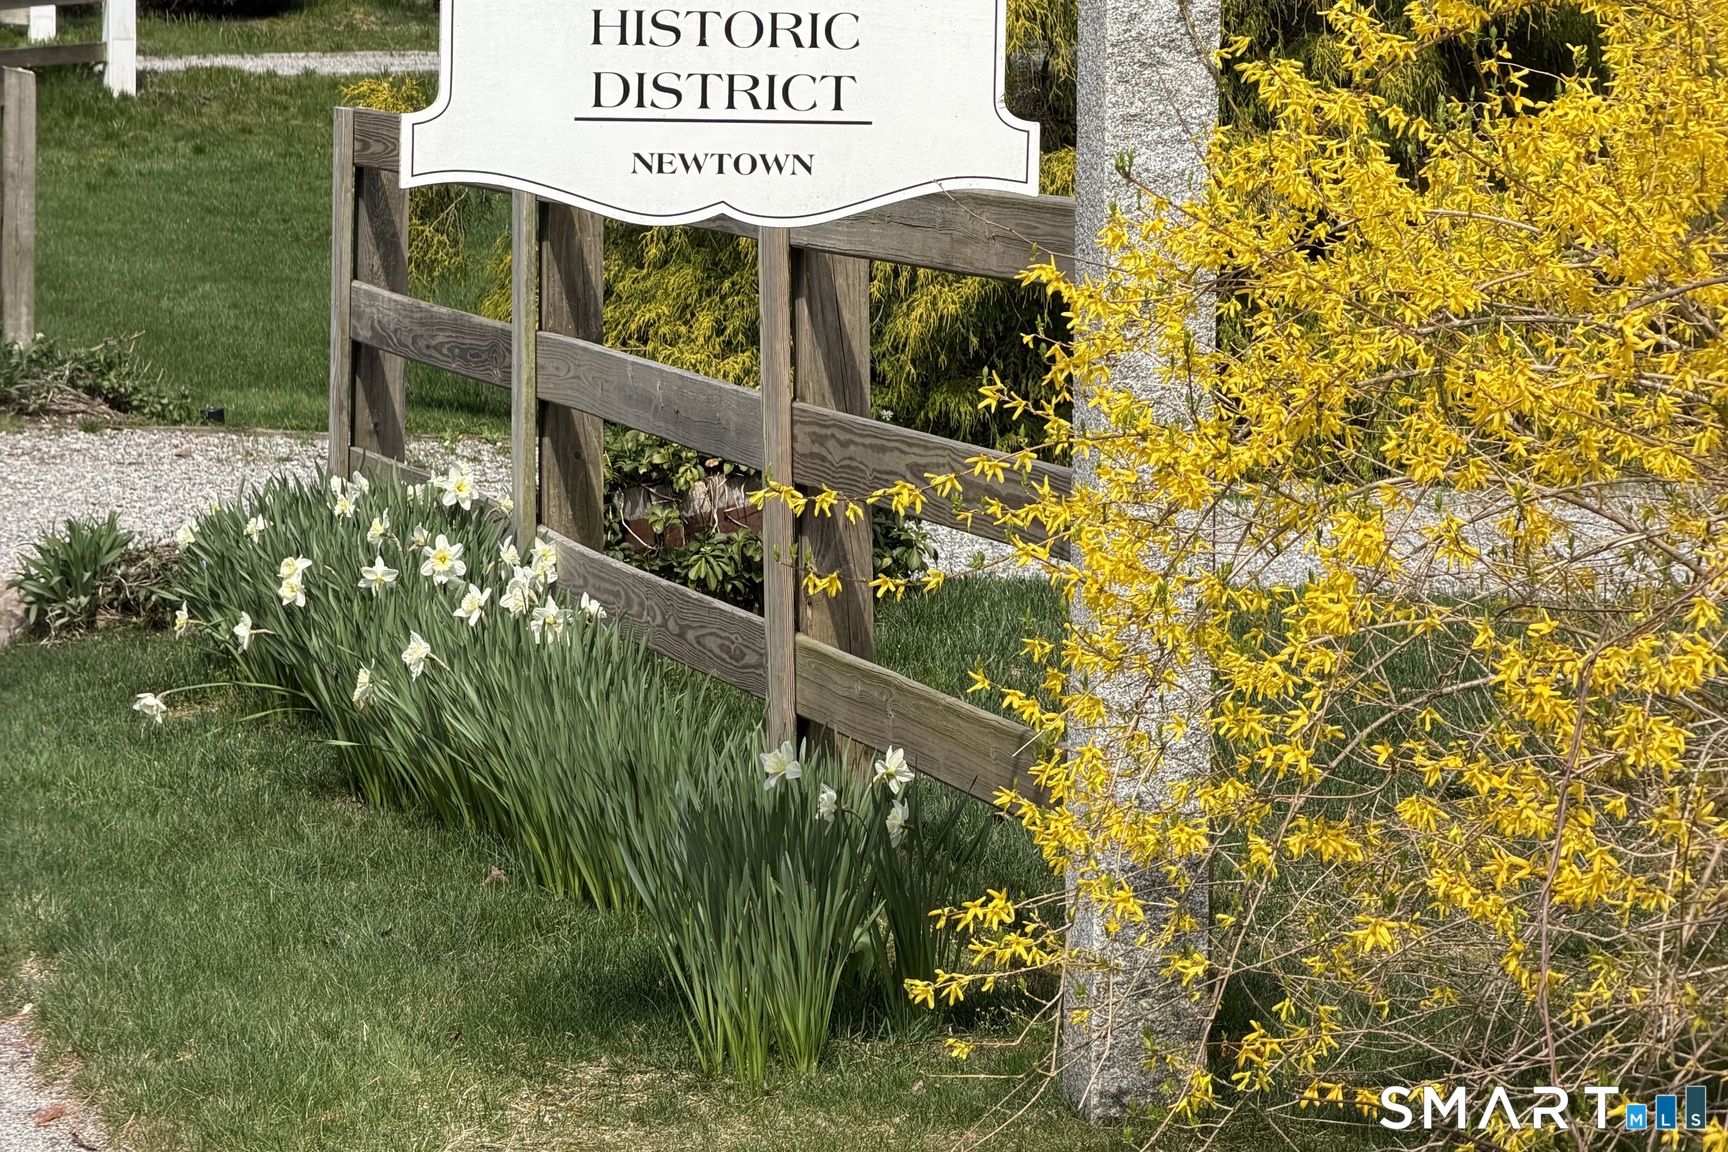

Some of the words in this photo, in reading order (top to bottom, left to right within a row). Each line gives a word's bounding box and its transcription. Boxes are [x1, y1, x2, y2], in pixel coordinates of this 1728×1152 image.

[590, 8, 860, 50] HISTORIC
[591, 71, 857, 112] DISTRICT
[631, 152, 815, 176] NEWTOWN
